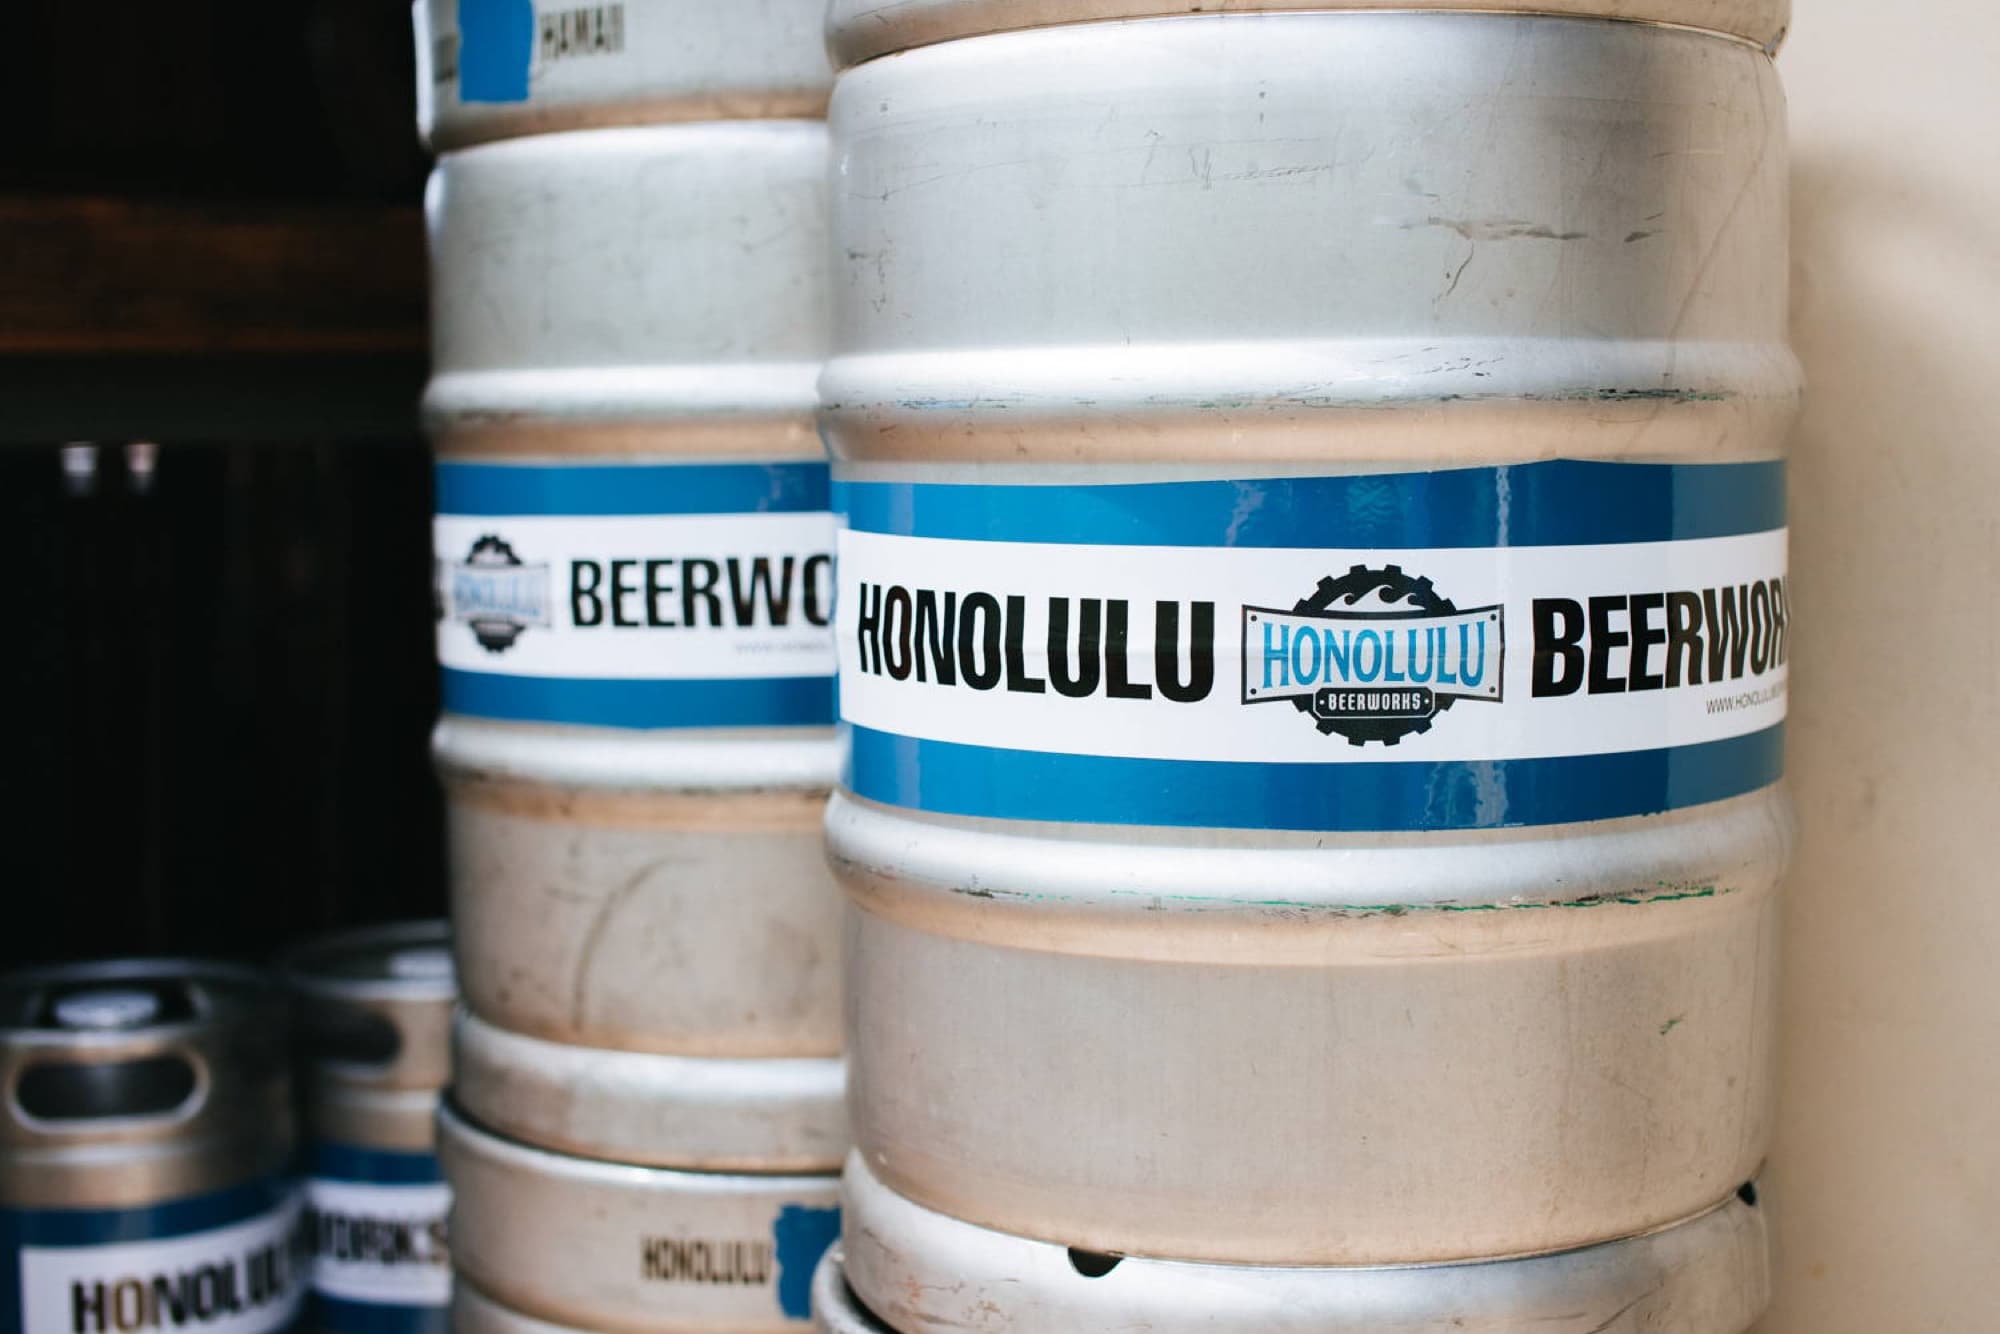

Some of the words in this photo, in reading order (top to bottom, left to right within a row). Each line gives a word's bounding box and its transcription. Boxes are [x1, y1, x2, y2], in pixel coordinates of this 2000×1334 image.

[858, 582, 1216, 703] HONOLULU
[1262, 620, 1486, 688] HONOLULU
[1327, 692, 1422, 711] BEERWORKS
